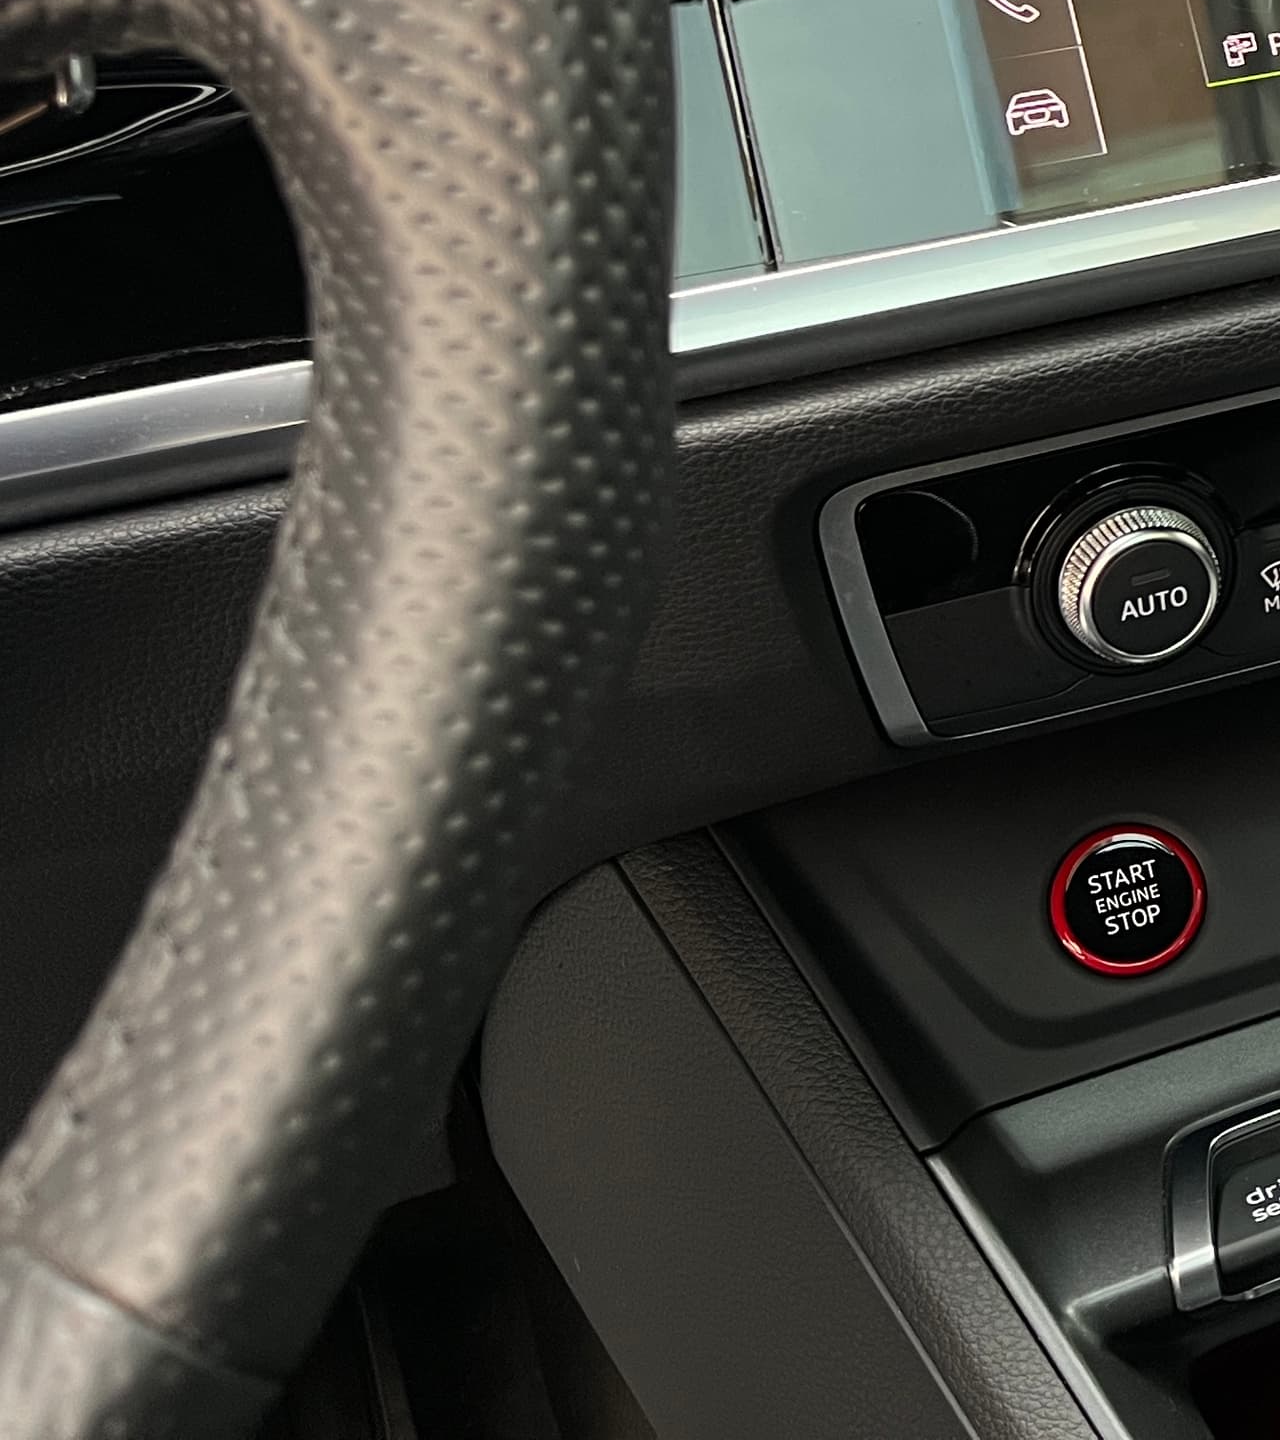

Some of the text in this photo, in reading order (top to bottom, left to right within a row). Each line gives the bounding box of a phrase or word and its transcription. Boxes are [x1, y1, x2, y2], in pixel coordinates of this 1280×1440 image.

[1120, 586, 1189, 622] AUTO
[1087, 859, 1156, 895] START
[1095, 883, 1161, 914] ENGINE
[1104, 904, 1161, 936] STOP
